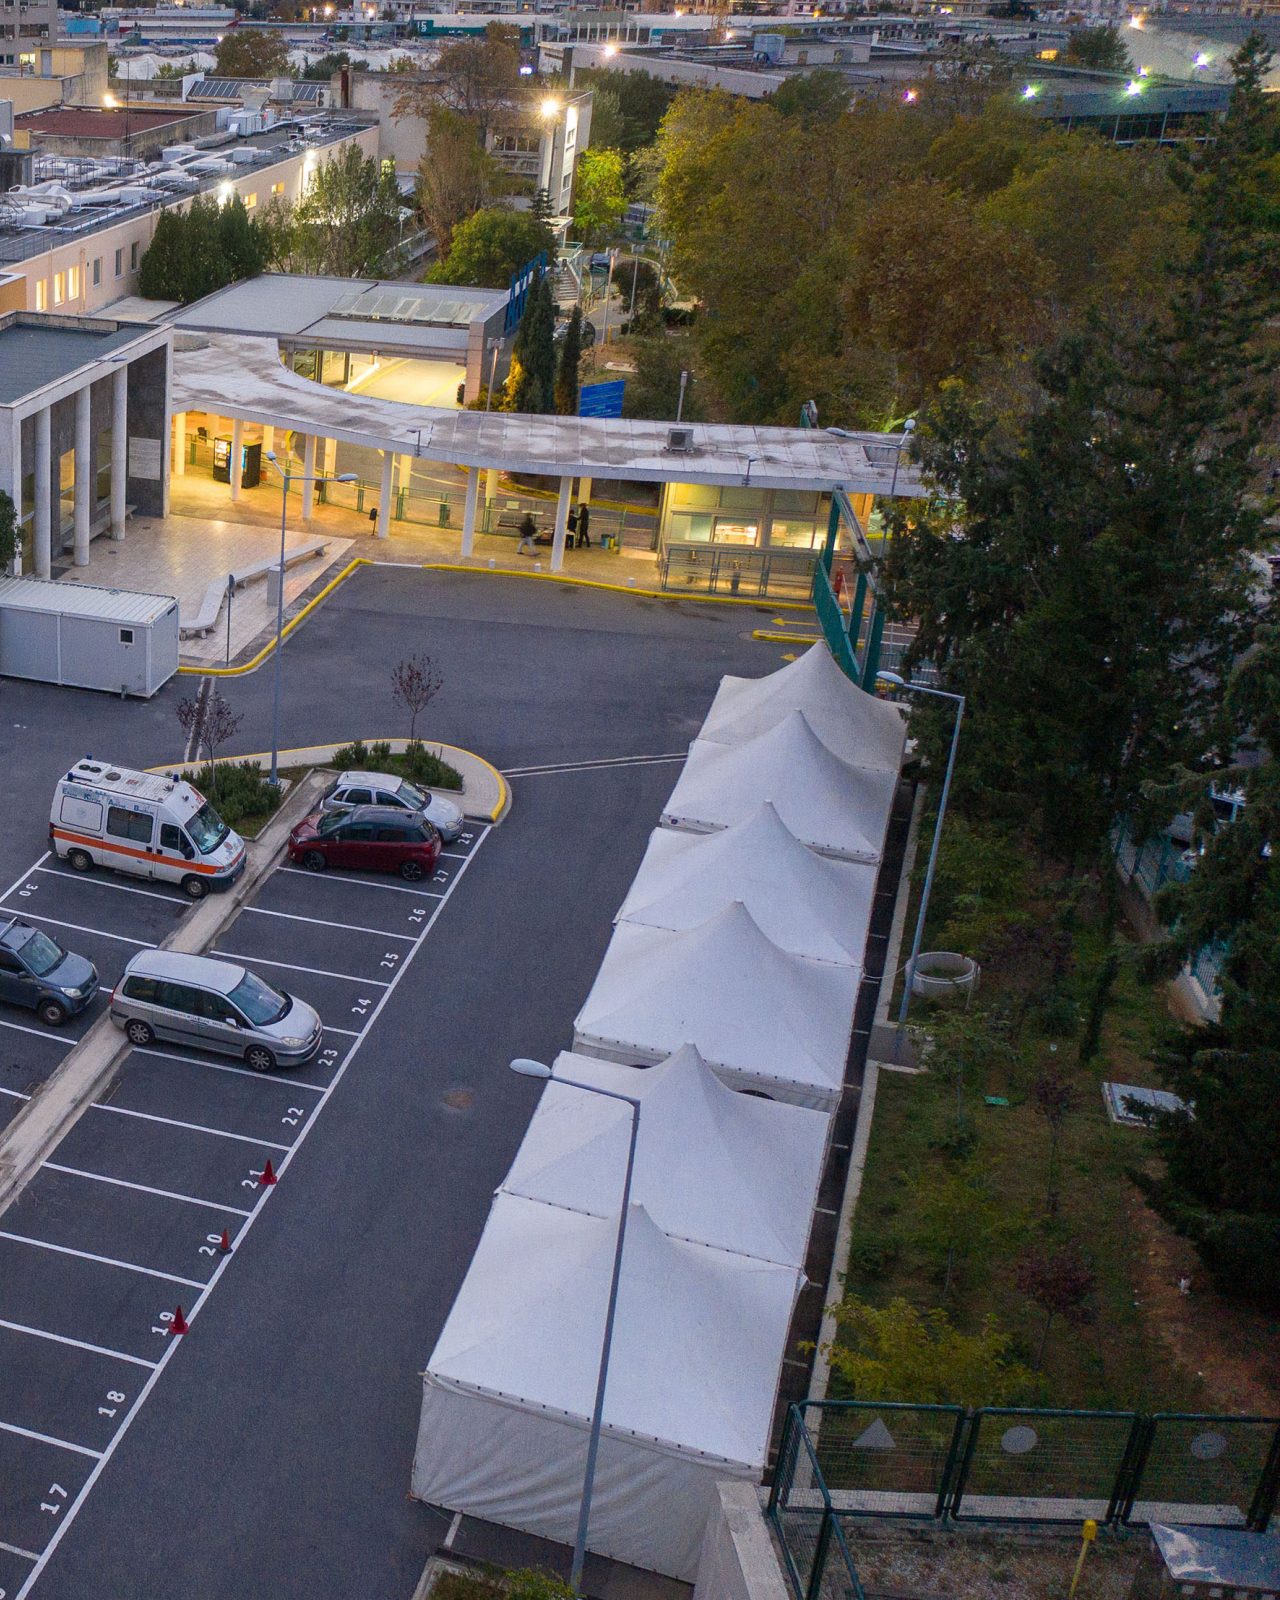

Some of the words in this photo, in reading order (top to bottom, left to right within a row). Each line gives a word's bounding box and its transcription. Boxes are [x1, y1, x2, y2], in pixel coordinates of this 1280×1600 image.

[457, 832, 474, 845] 28
[433, 870, 449, 883] 27
[18, 883, 39, 897] 30
[408, 908, 426, 923] 26
[380, 952, 399, 968] 25
[351, 998, 372, 1015] 24
[318, 1049, 339, 1067] 23
[281, 1107, 304, 1126] 22
[241, 1168, 265, 1190] 21
[198, 1233, 223, 1257] 20
[151, 1311, 176, 1337] 19
[98, 1390, 126, 1419] 18
[40, 1483, 68, 1515] 17
